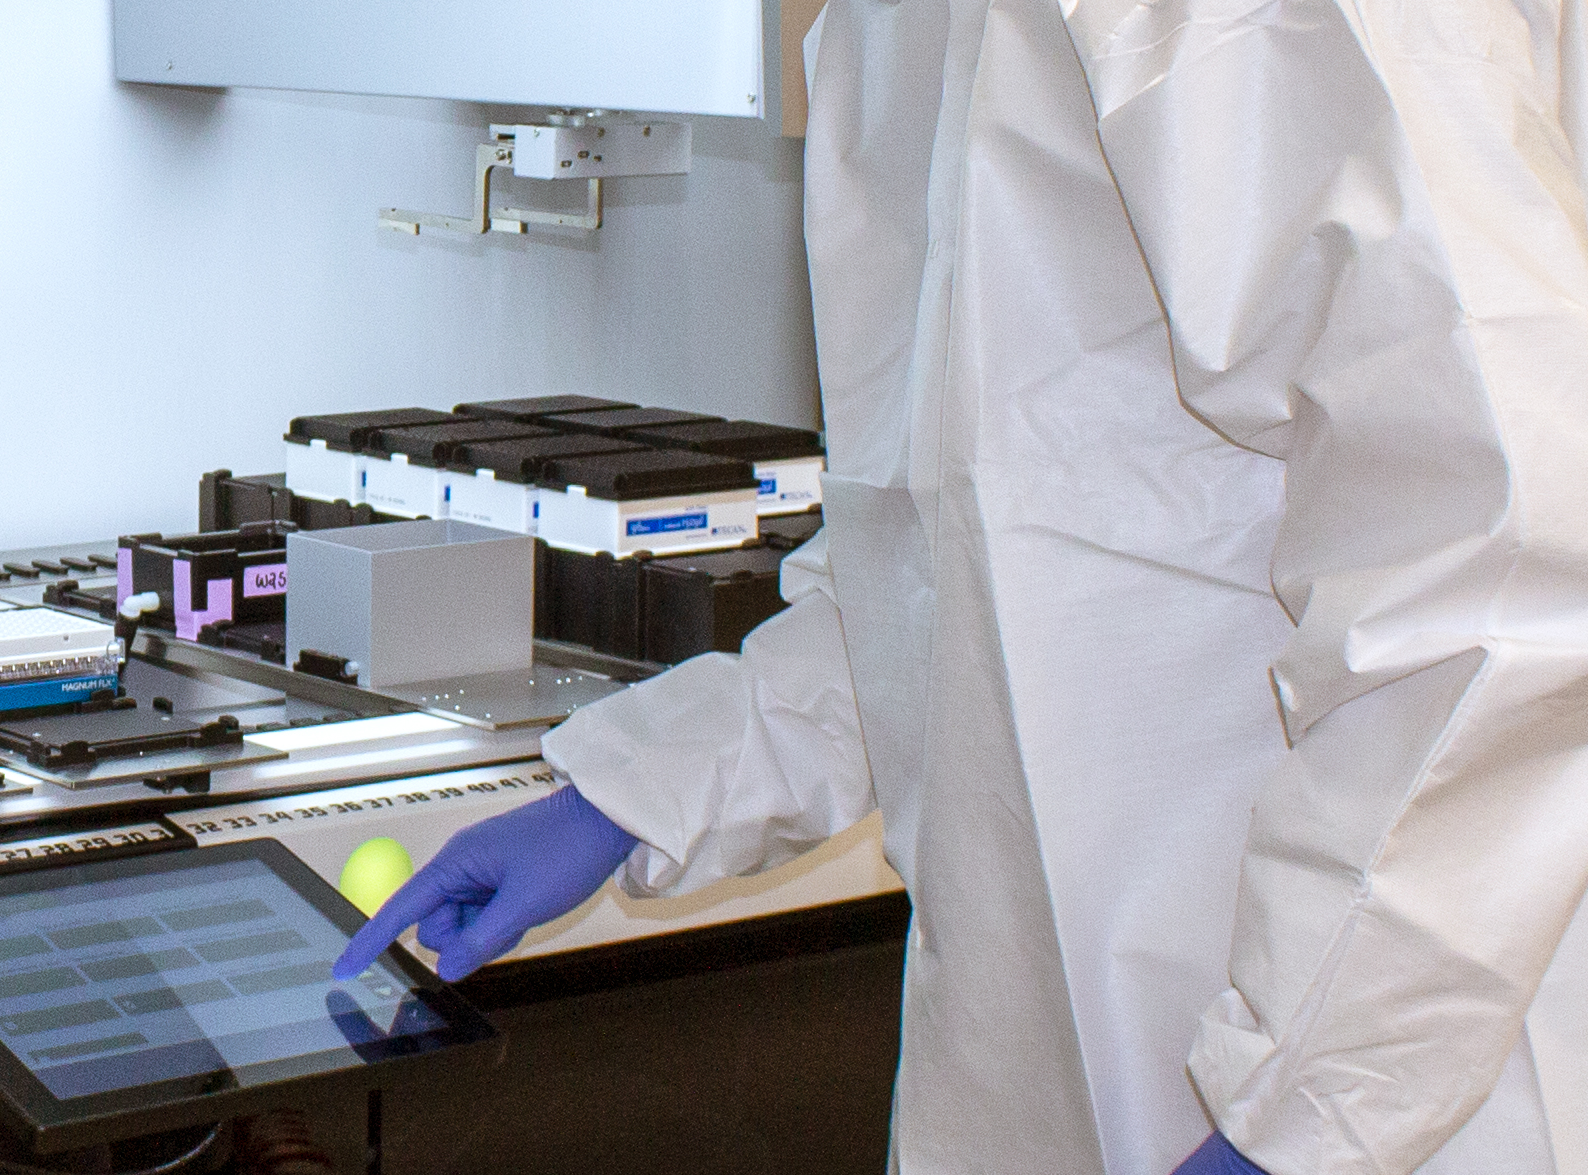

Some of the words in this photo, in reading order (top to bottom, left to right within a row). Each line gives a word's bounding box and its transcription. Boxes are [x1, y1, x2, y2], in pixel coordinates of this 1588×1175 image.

[61, 680, 97, 691] MAGNUM
[186, 821, 222, 835] 32
[223, 817, 257, 829] 33
[259, 812, 293, 824] 34
[295, 808, 328, 818] 35
[331, 802, 363, 814] 36
[365, 798, 393, 809] 37
[398, 793, 431, 804] 38
[433, 788, 464, 799] 39
[468, 783, 498, 793] 40
[500, 778, 528, 788] 41
